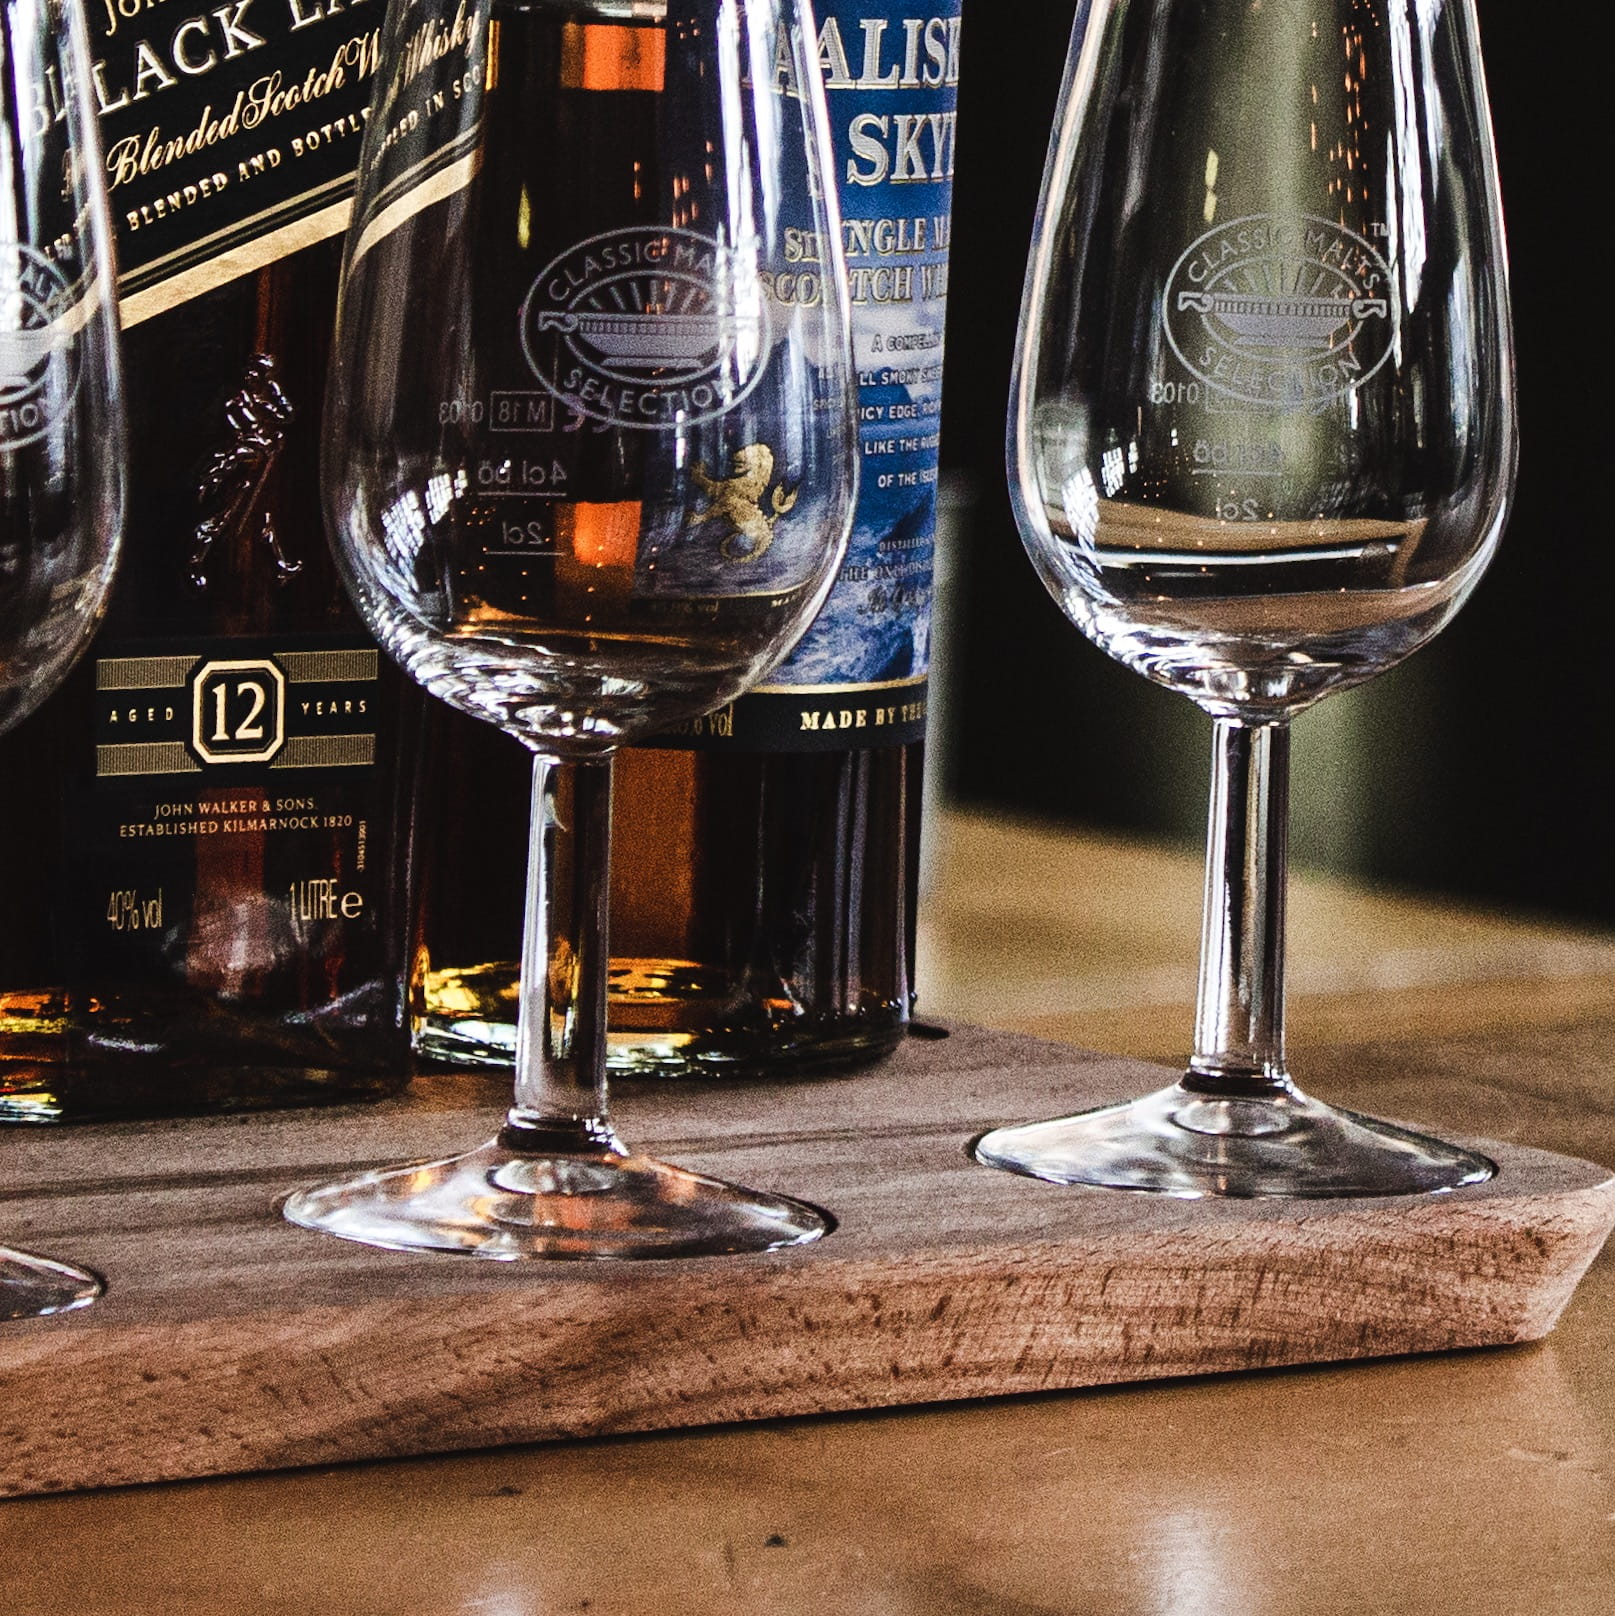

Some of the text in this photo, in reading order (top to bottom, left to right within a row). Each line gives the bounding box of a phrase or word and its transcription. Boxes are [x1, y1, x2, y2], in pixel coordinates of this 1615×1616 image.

[104, 95, 242, 192] Blended
[241, 44, 346, 131] Scotch
[125, 172, 228, 231] BLENDED
[238, 146, 282, 183] AND
[548, 240, 662, 302] CLASSIC
[1304, 228, 1381, 290] MALTS
[864, 440, 895, 455] LIKE
[900, 437, 919, 452] THE
[877, 474, 893, 489] OF
[898, 472, 917, 486] THE
[109, 680, 367, 743] AGED 12 YEARS
[799, 704, 868, 733] MADE
[875, 703, 897, 727] BY
[119, 814, 353, 838] ESTABLISHED KILMARNOCK 1820
[153, 803, 194, 820] JOHN
[197, 799, 258, 815] WALKER
[261, 800, 272, 813] &
[106, 887, 163, 931] 40% vol
[289, 878, 364, 921] 1 LITRE e
